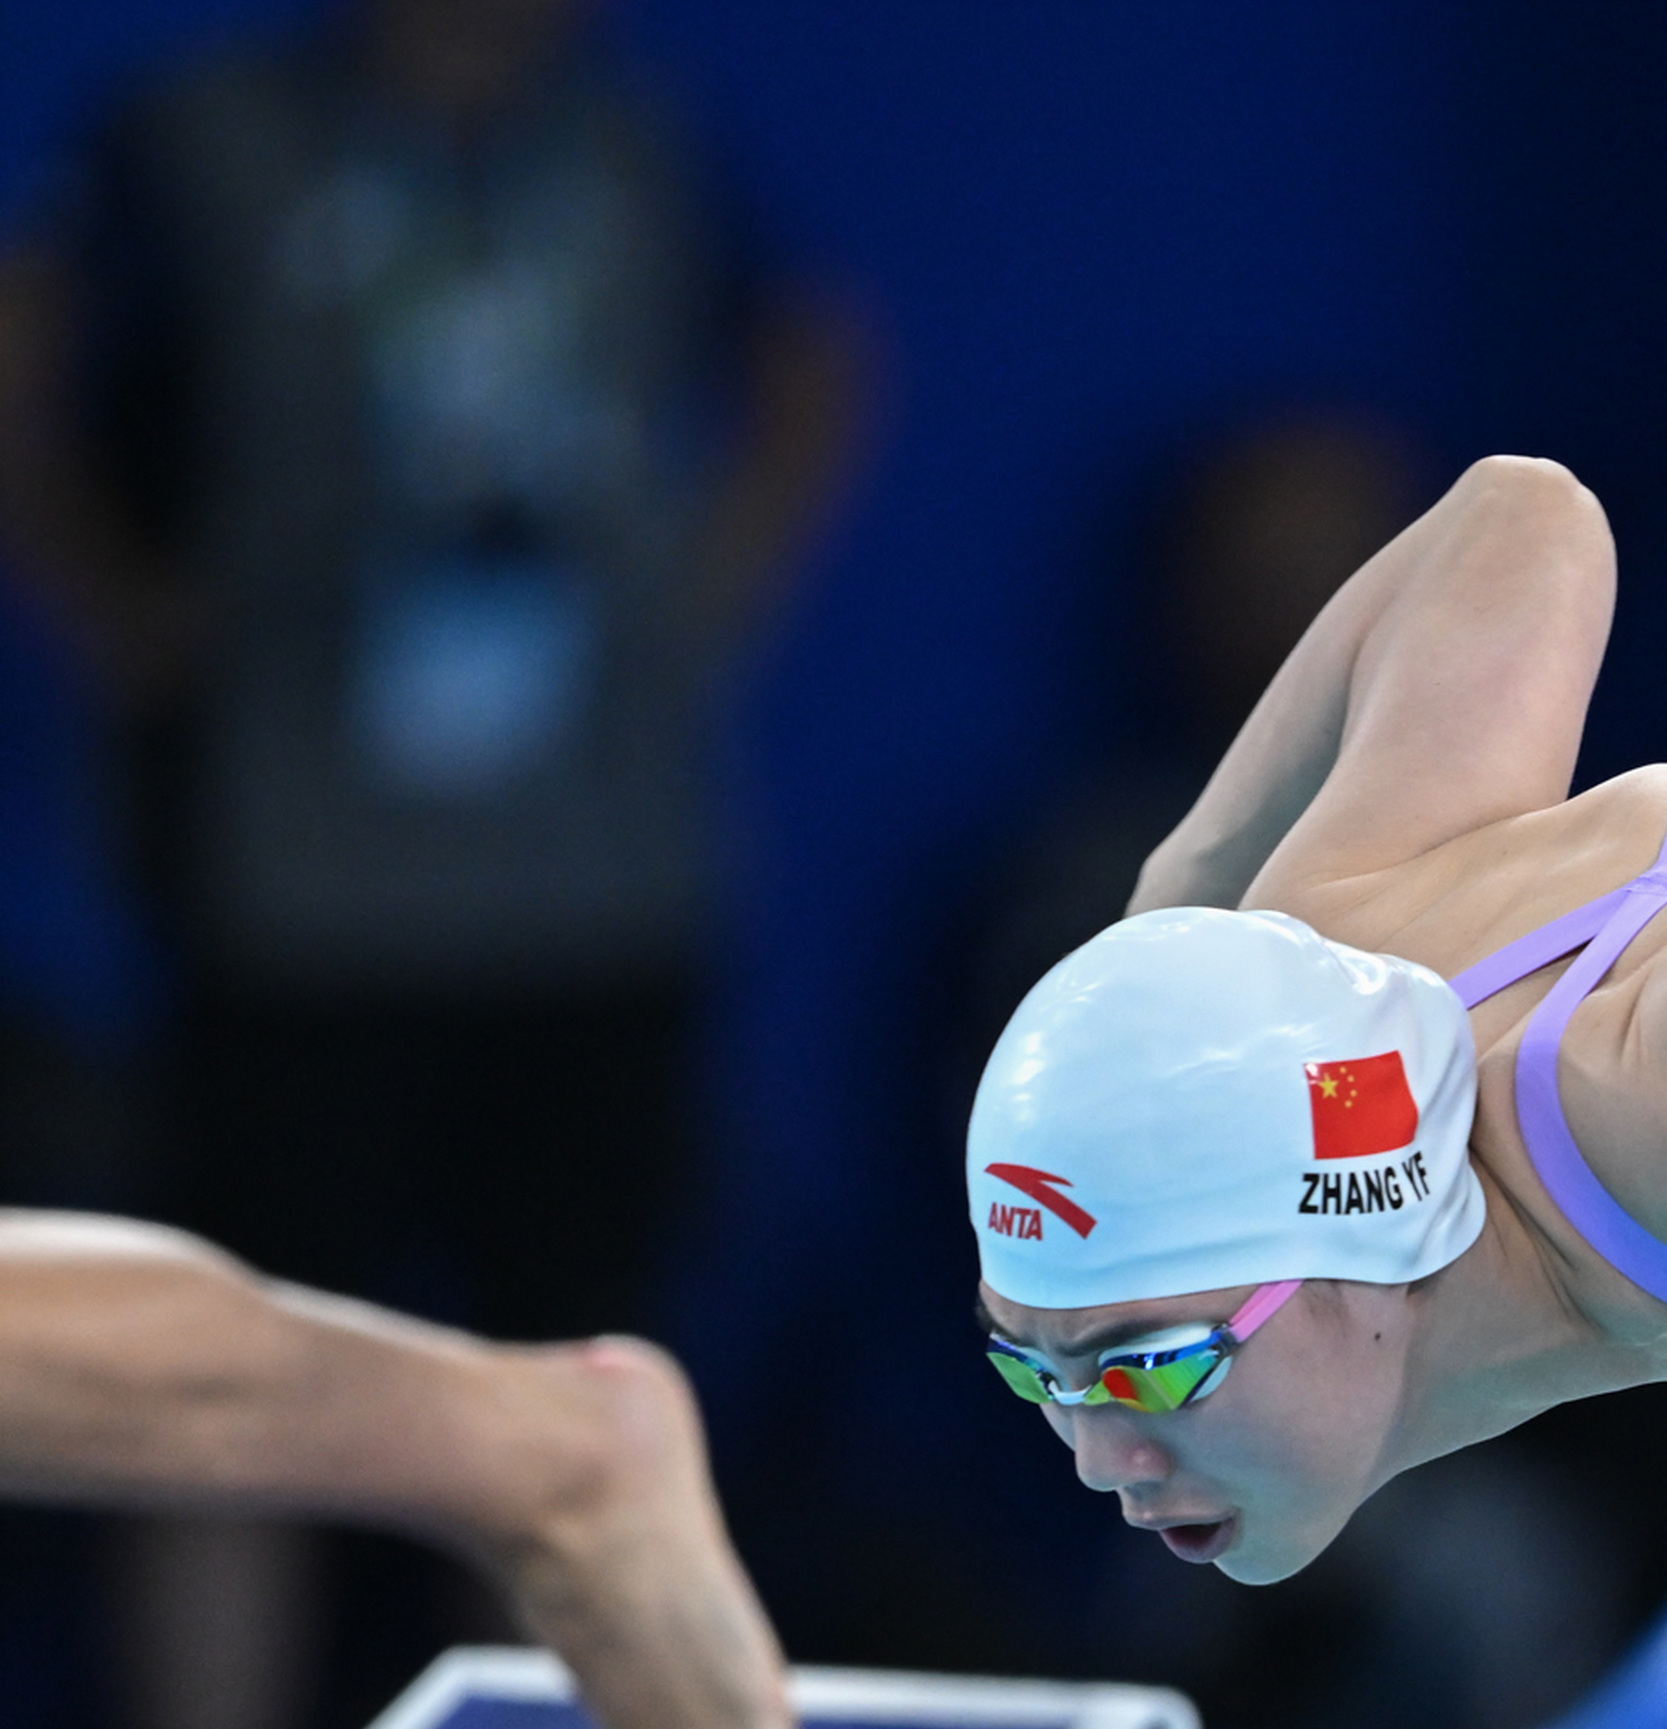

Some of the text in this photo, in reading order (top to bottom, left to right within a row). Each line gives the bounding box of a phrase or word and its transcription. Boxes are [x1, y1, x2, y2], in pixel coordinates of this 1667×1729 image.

[1298, 1151, 1430, 1215] ZHANG YF
[988, 1202, 1043, 1241] ANTA
